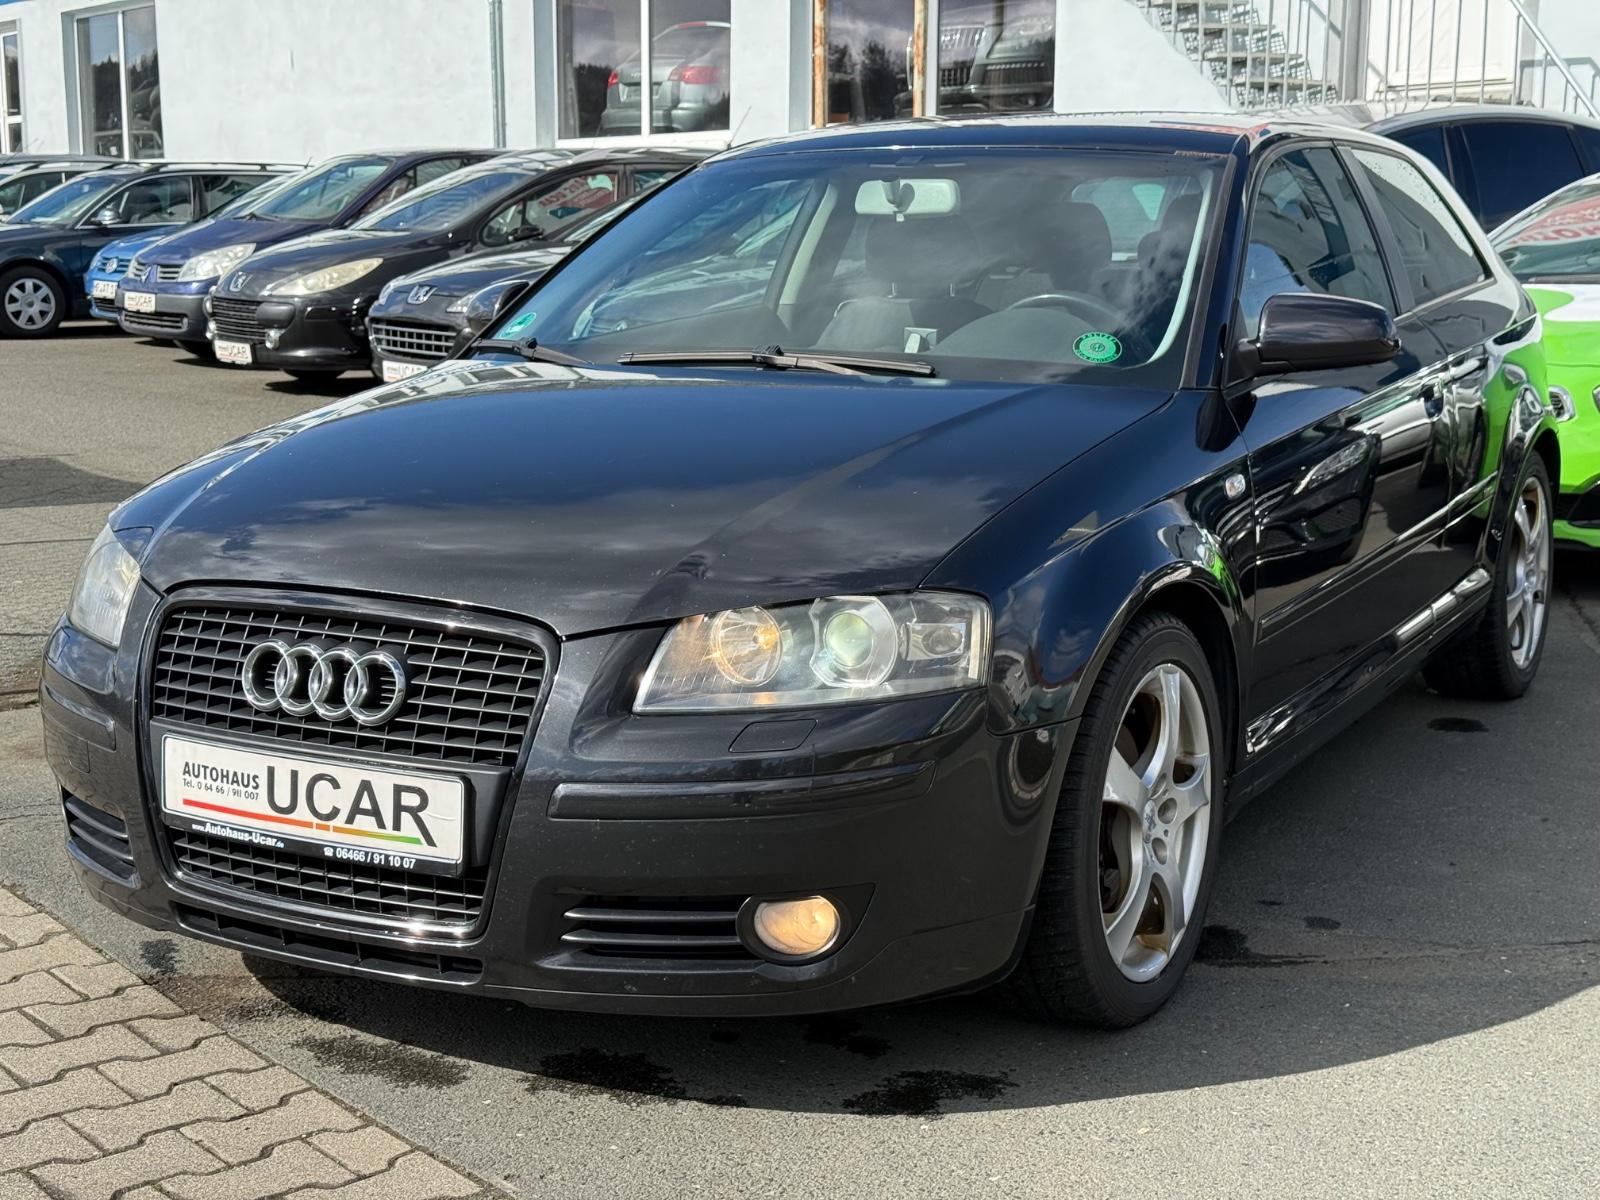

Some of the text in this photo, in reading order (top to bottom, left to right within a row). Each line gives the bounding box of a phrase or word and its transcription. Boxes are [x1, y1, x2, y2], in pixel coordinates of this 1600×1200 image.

[182, 761, 260, 790] AUTOHAUS
[182, 778, 195, 789] Tel.
[197, 781, 203, 790] 0
[204, 783, 213, 792] 64
[215, 785, 225, 794] 66
[232, 788, 242, 798] 911
[244, 790, 259, 801] 007
[266, 765, 438, 848] UCAR
[191, 822, 285, 848] www.Autohaus-Ucar.de
[335, 847, 416, 869] 06466 / 91 10 07
